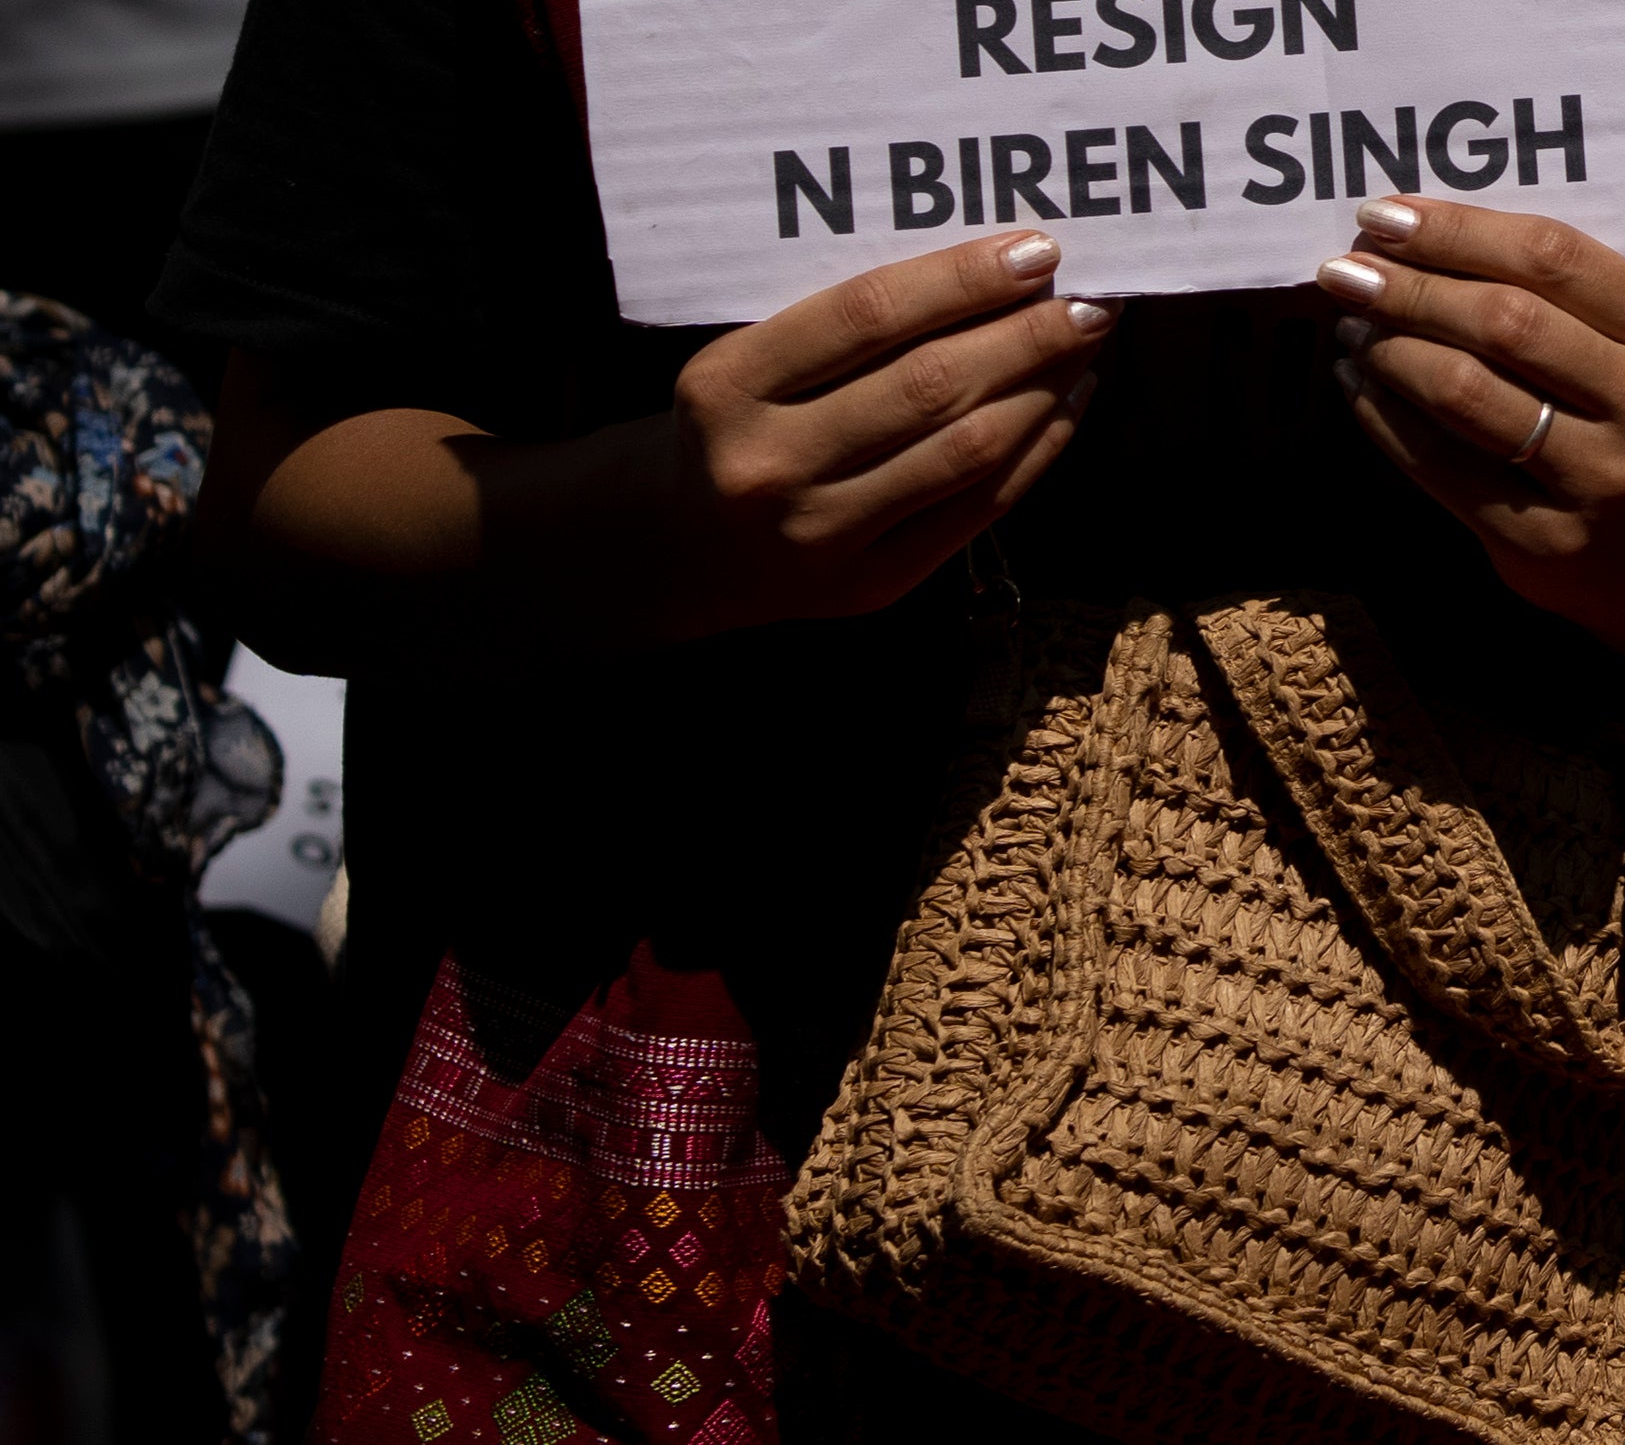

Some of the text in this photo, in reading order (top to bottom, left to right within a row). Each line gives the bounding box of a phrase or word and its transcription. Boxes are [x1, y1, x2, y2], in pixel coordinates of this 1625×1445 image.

[774, 95, 1587, 239] N BIREN SINGH
